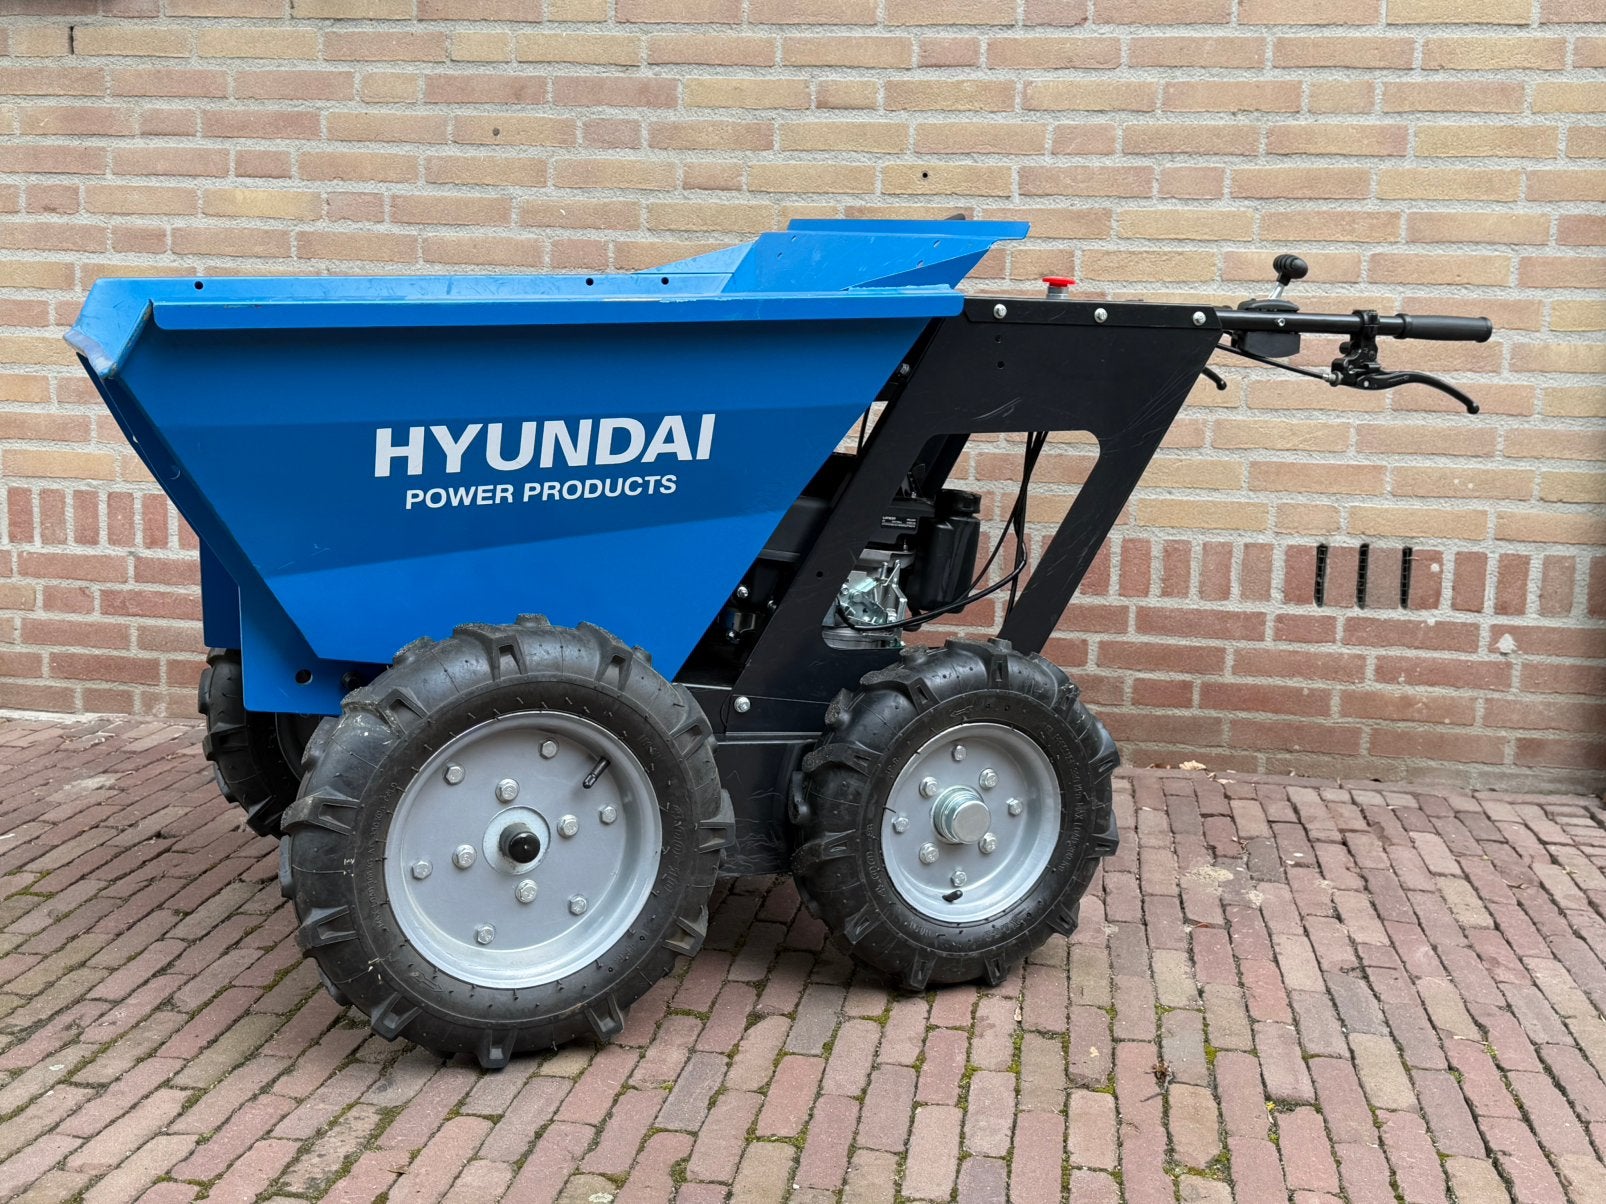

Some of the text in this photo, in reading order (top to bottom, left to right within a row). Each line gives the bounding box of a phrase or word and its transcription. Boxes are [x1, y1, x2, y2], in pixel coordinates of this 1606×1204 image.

[374, 413, 716, 477] HYUNDAI
[405, 474, 677, 510] POWER PRODUCTS
